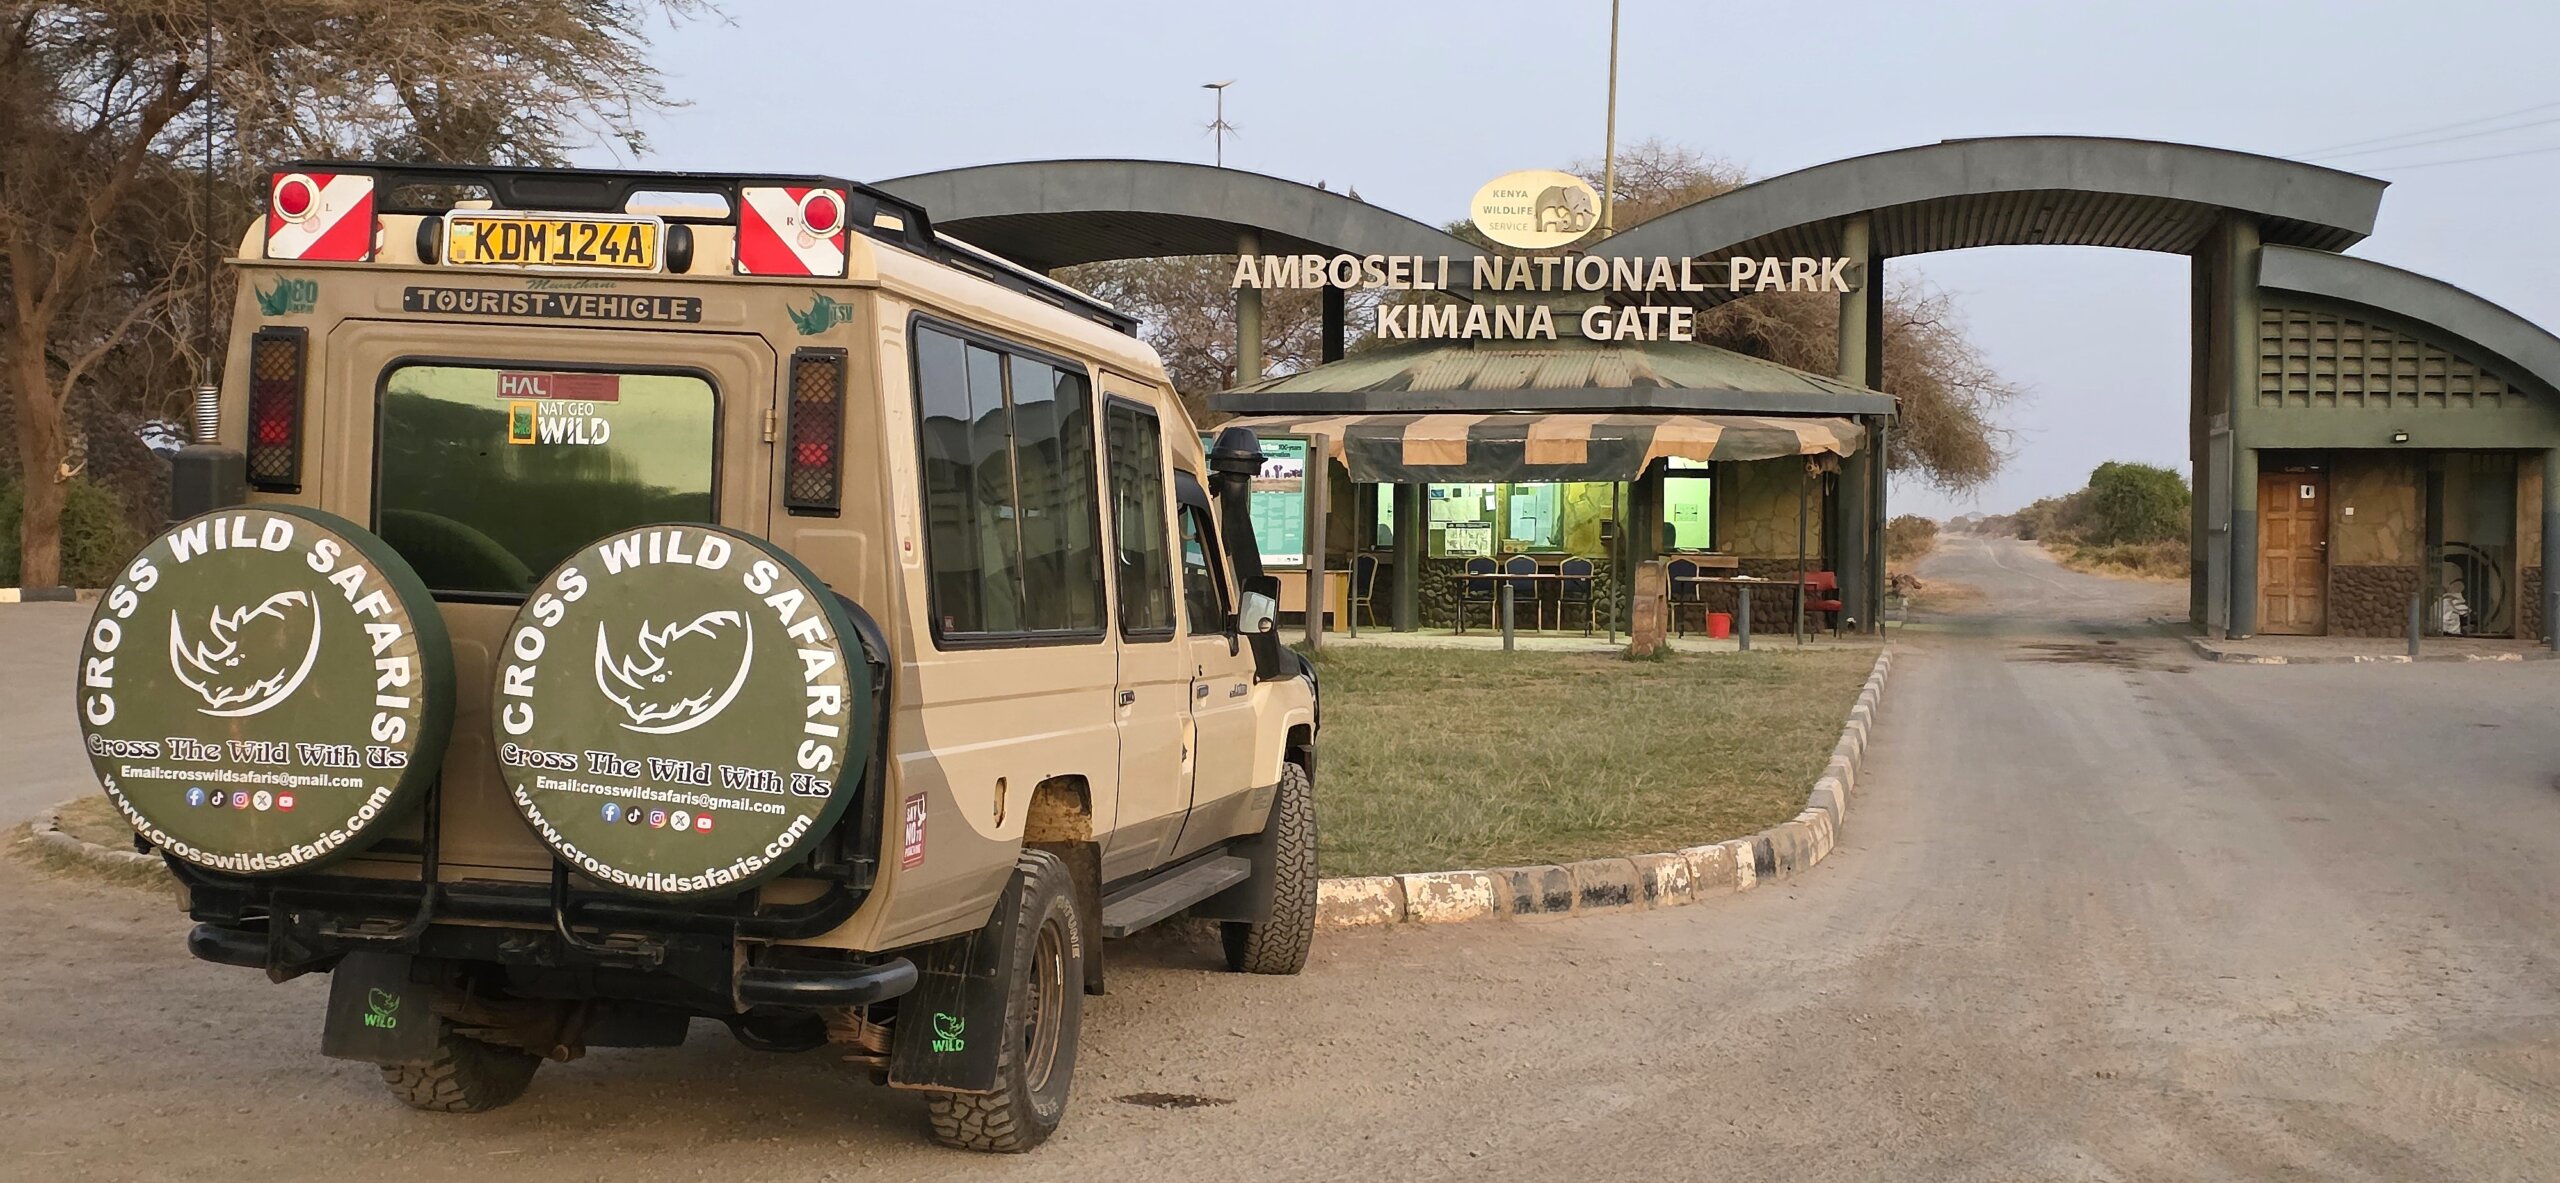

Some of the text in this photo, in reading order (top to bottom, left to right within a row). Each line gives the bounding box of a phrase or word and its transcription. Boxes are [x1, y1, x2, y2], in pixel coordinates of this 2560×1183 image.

[1492, 189, 1529, 198] KENYA
[325, 202, 332, 212] L
[1483, 205, 1533, 215] WILDLIFE
[786, 216, 794, 226] R
[1489, 221, 1528, 231] SERVICE
[1231, 253, 1851, 293] AMBOSELI NATIONAL PARK
[291, 278, 319, 303] 80
[418, 288, 688, 321] TOURIST VEHICLE
[831, 305, 853, 321] TSV
[1376, 303, 1694, 342] KIMANA GATE
[502, 376, 546, 394] HAL
[539, 401, 594, 416] NAT GEO
[537, 416, 611, 445] WILD
[85, 515, 411, 745] CROSS WILD SAFARIS
[503, 530, 841, 774] CROSS WILD SAFARIS
[88, 733, 408, 770] Cross The Wild With Us
[500, 742, 832, 798] Cross The Wild With Us
[102, 773, 391, 872] www.crosswildsafaris.com
[906, 805, 917, 822] SAY
[513, 783, 813, 894] www.crosswildsafaris.com
[905, 822, 917, 846] NO
[364, 1013, 397, 1028] WILD
[932, 1039, 965, 1053] WILD
